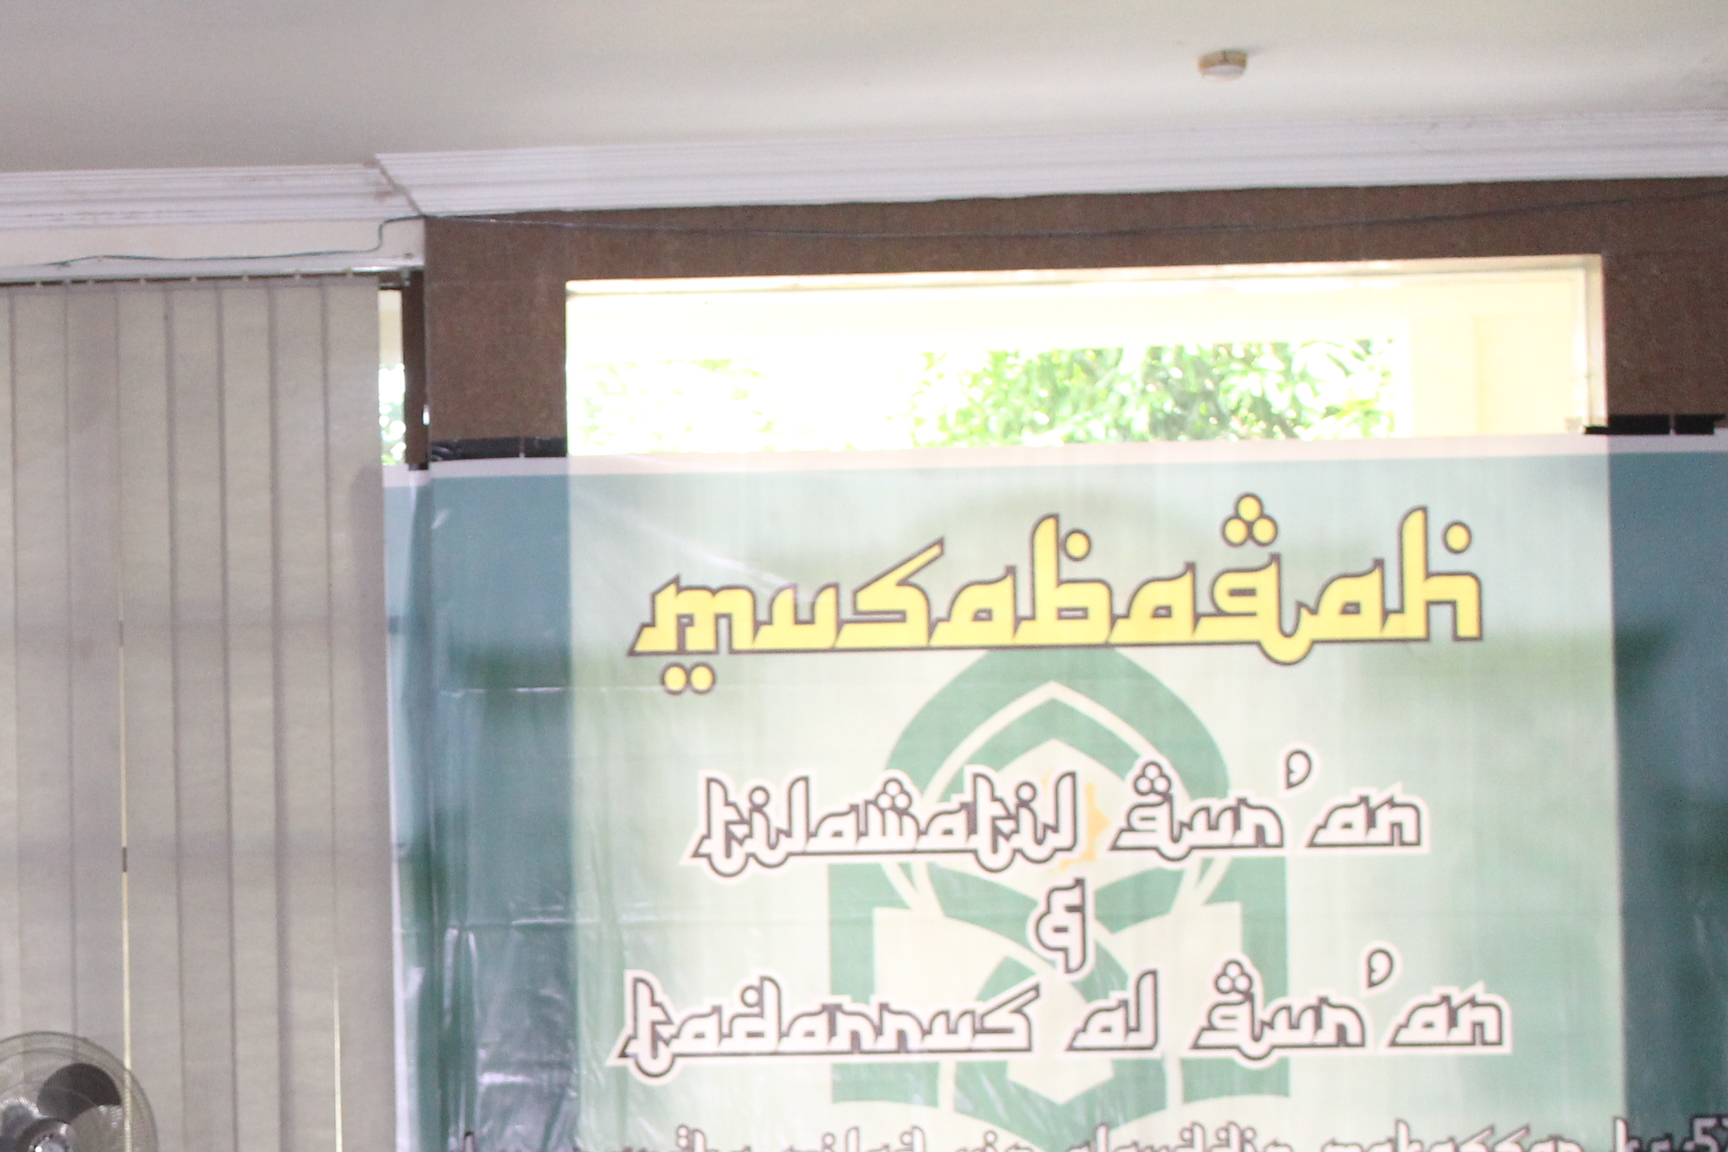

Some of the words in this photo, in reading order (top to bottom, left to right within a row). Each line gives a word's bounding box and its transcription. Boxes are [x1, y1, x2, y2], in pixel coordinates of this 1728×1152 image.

[627, 493, 1484, 695] musabaqah
[688, 771, 1079, 878] tilawatil
[1066, 968, 1159, 1054] al
